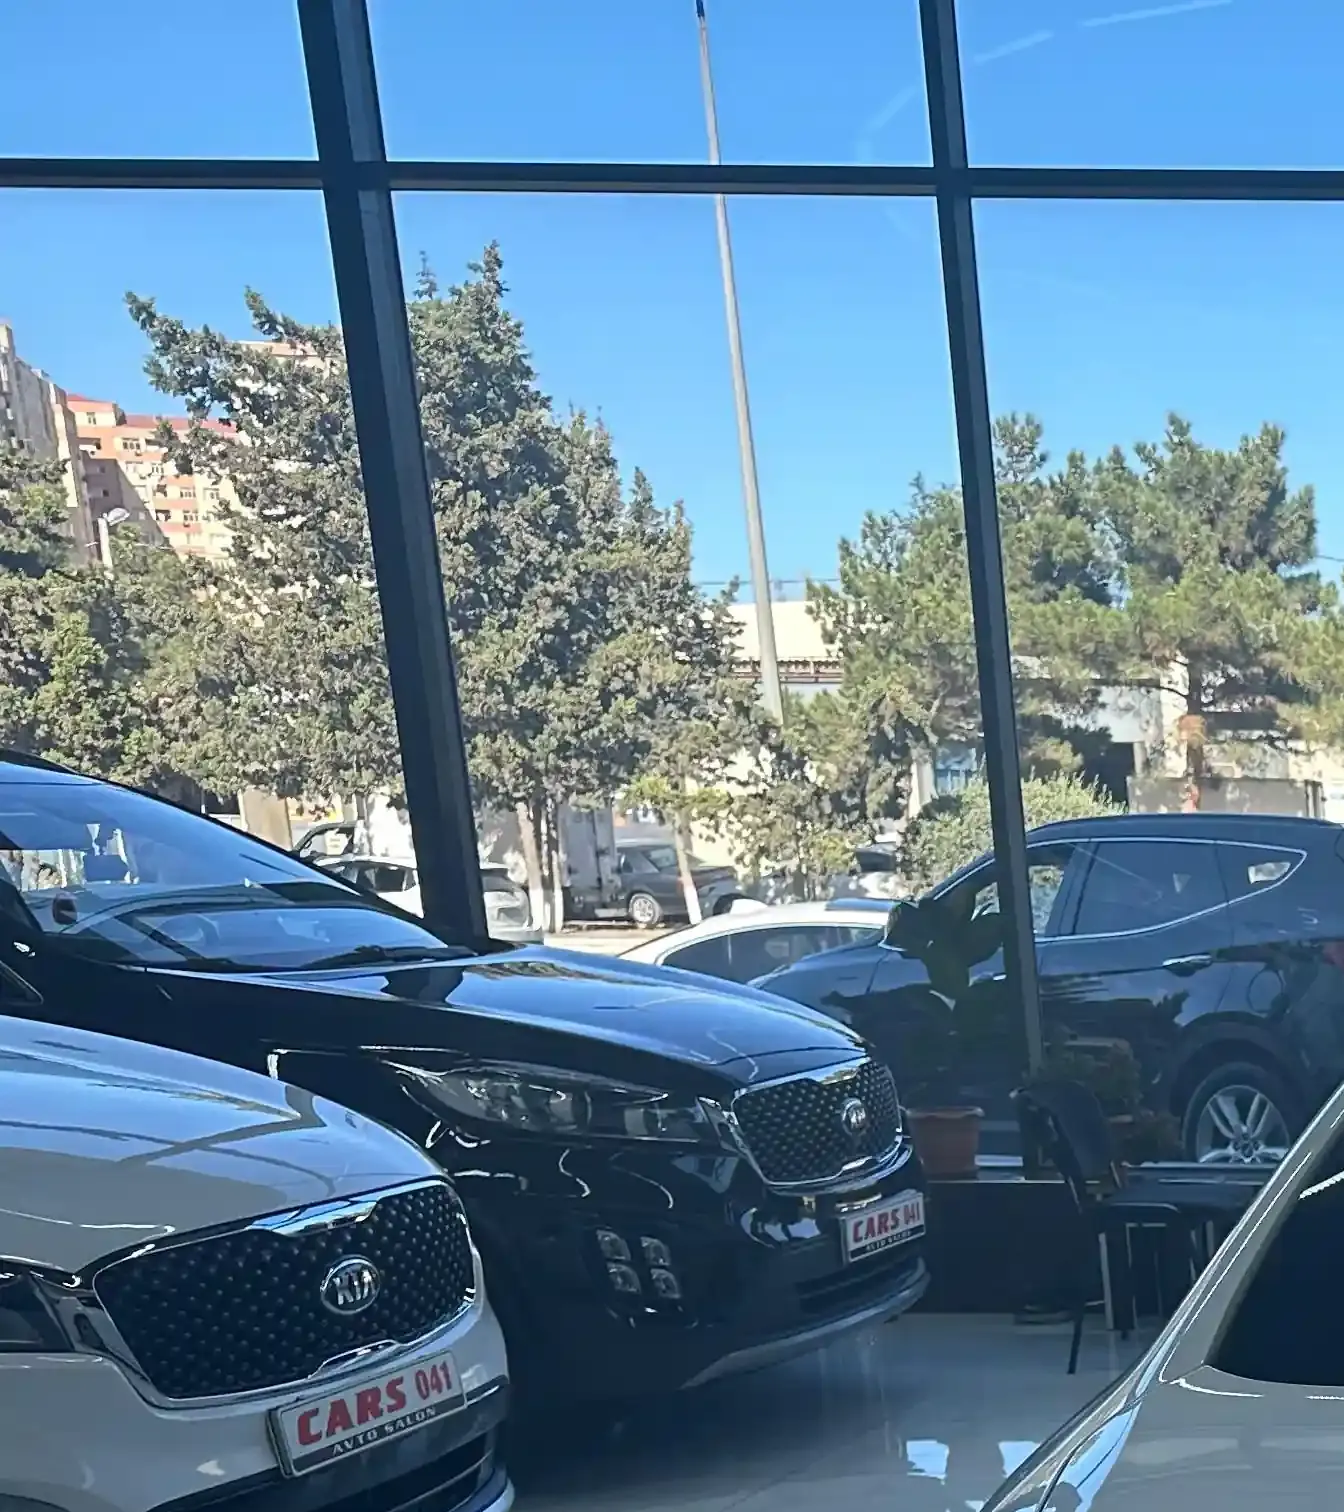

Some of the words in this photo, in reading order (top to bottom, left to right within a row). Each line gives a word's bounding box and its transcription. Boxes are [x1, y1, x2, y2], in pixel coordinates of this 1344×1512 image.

[852, 1208, 901, 1244] CARS
[297, 1376, 407, 1446] CARS
[414, 1361, 453, 1401] 041
[332, 1429, 378, 1456] AVTO
[383, 1406, 437, 1434] SALON
